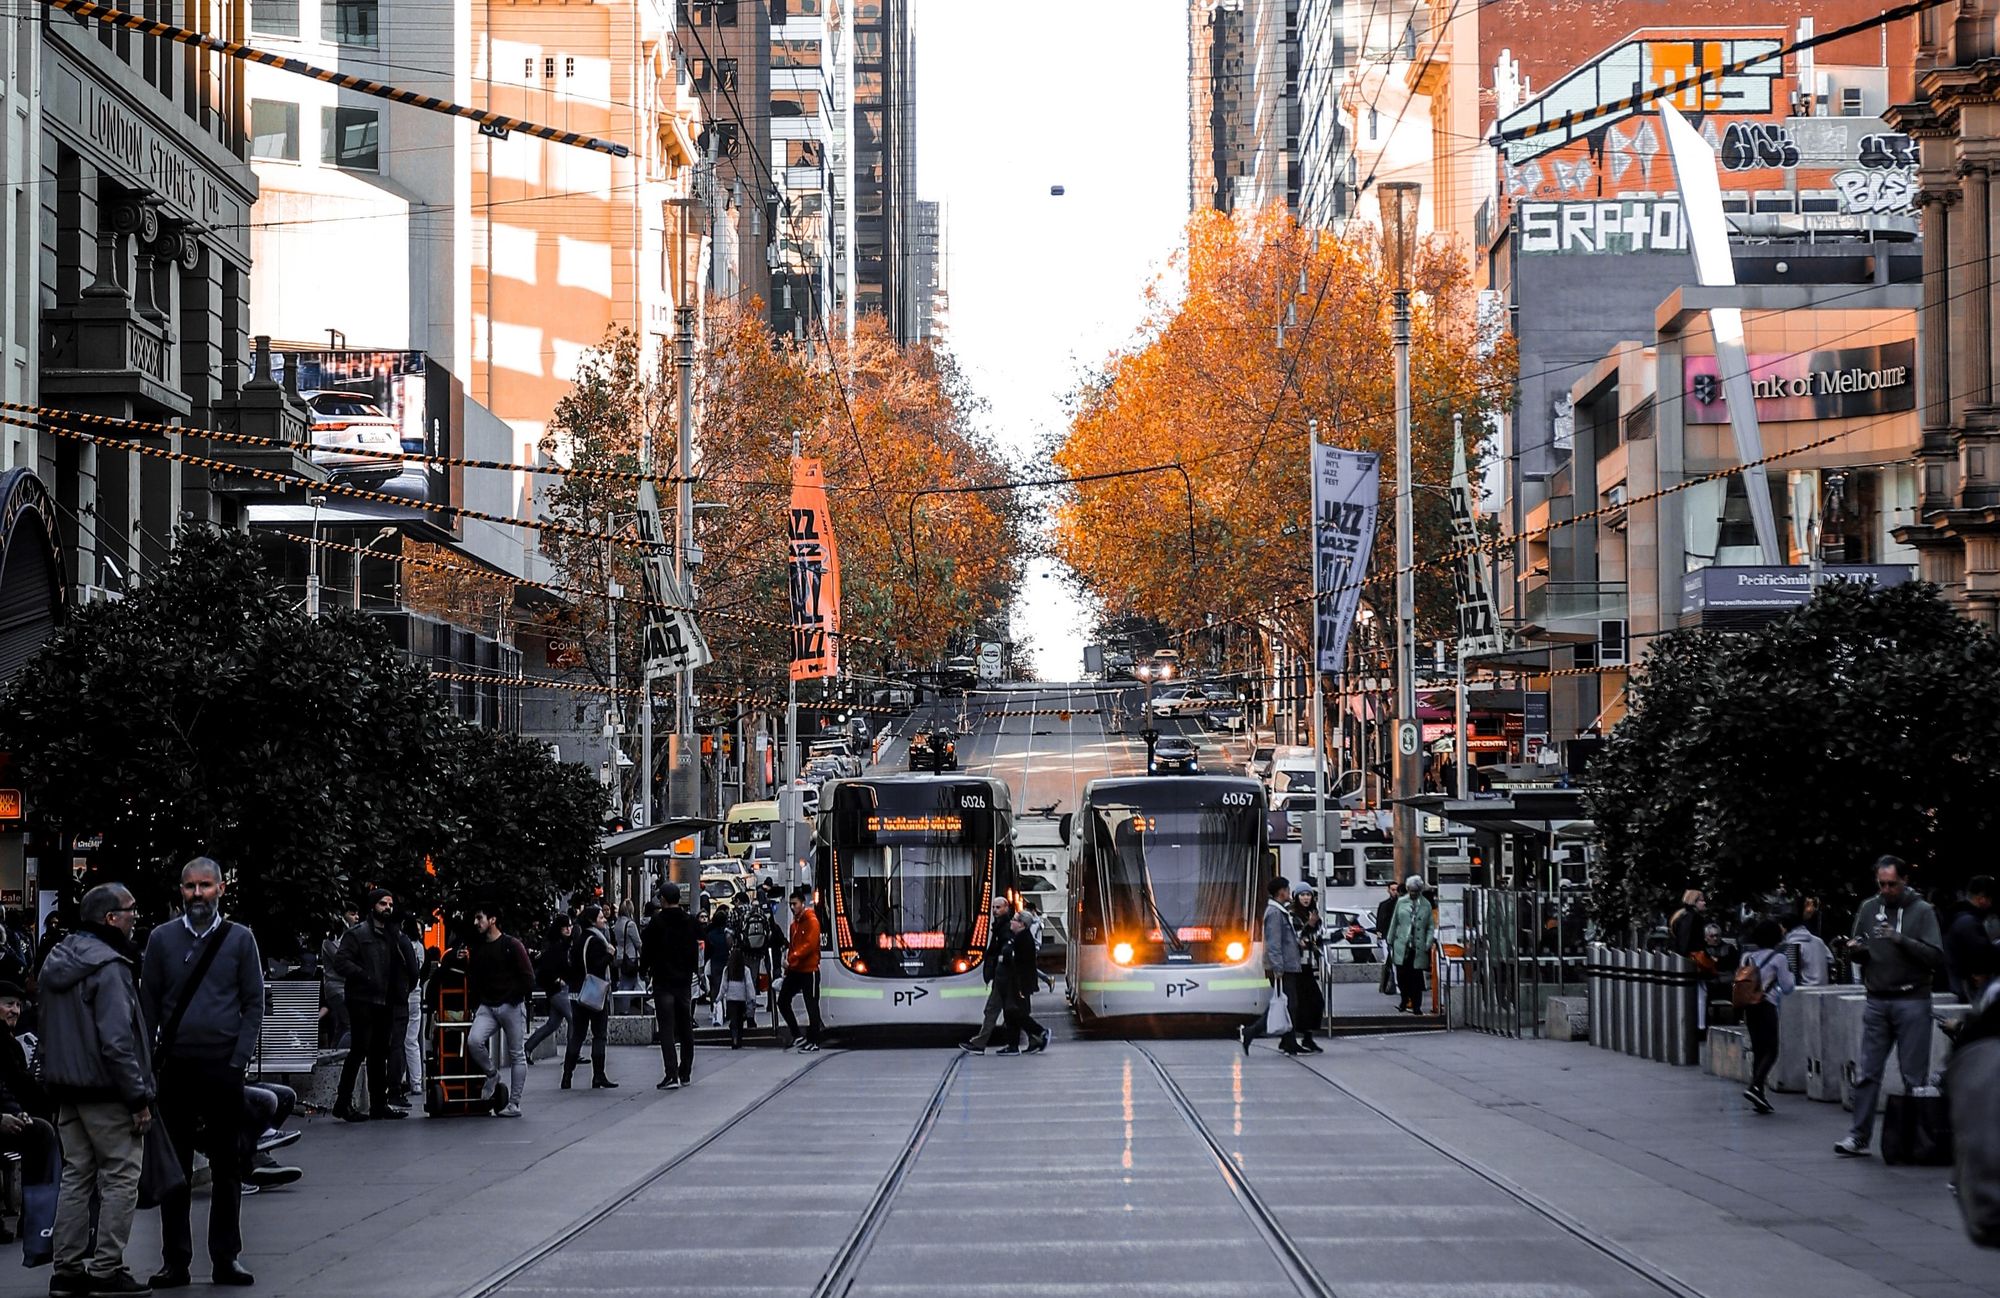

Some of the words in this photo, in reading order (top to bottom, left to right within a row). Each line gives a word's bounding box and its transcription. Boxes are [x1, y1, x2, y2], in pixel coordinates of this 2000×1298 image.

[89, 86, 143, 174] LONDON
[150, 137, 196, 212] STORES
[1790, 372, 1814, 396] of
[1820, 365, 1906, 393] Melbourne
[1325, 477, 1339, 486] FEST
[660, 545, 672, 555] 35
[961, 795, 986, 809] 6026
[1222, 793, 1254, 806] 6067
[3, 893, 21, 902] sale
